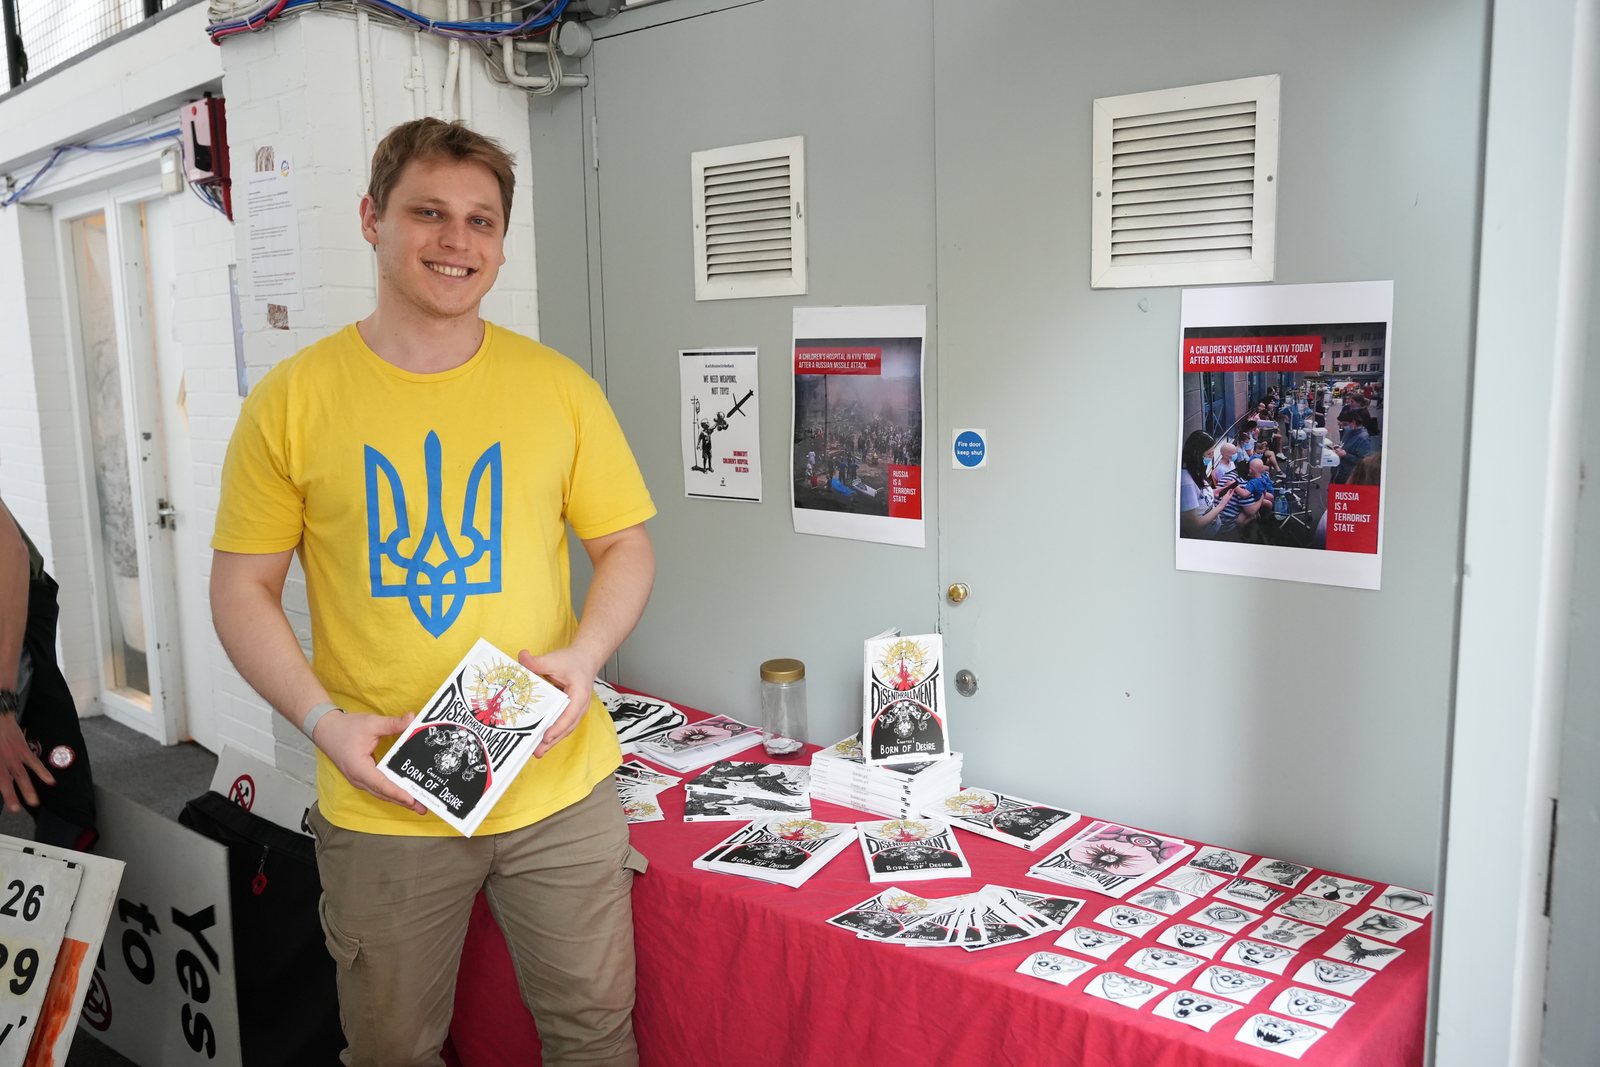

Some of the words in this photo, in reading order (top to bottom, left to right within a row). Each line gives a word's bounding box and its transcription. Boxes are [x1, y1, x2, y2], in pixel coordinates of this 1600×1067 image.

[1196, 345, 1232, 354] CHILDREN'S
[1234, 345, 1264, 353] HOSPITAL
[1274, 344, 1289, 352] KYIV
[1291, 344, 1313, 352] TODAY
[1190, 356, 1209, 364] AFTER
[1216, 356, 1243, 364] RUSSIAN
[1272, 355, 1297, 363] ATTACK
[893, 487, 916, 495] TERRORIST
[1335, 492, 1359, 500] RUSSIA
[1334, 502, 1341, 510] IS
[1334, 513, 1371, 523] TERRORIST
[1334, 523, 1355, 532] STATE
[880, 744, 899, 754] BORN
[401, 759, 424, 781] BORN
[425, 779, 439, 790] OF
[886, 865, 908, 875] BORN
[0, 880, 44, 921] 26
[118, 898, 161, 985] to
[172, 904, 220, 1060] Yes
